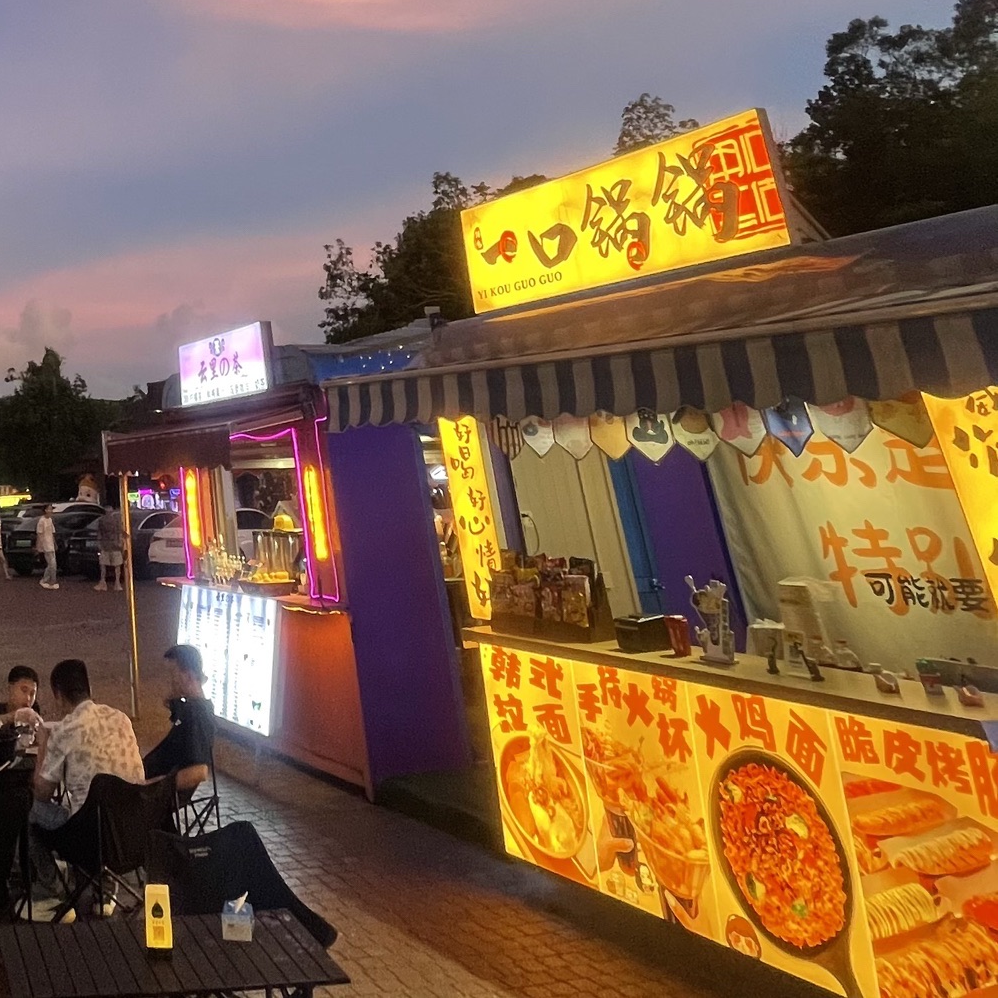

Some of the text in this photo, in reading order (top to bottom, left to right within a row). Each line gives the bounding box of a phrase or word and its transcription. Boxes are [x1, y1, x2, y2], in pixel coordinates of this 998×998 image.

[477, 271, 563, 300] YI KOU GUO GUO
[864, 573, 990, 612] 可能就要
[493, 693, 573, 744] 拉面
[694, 693, 828, 789] 火鸡面
